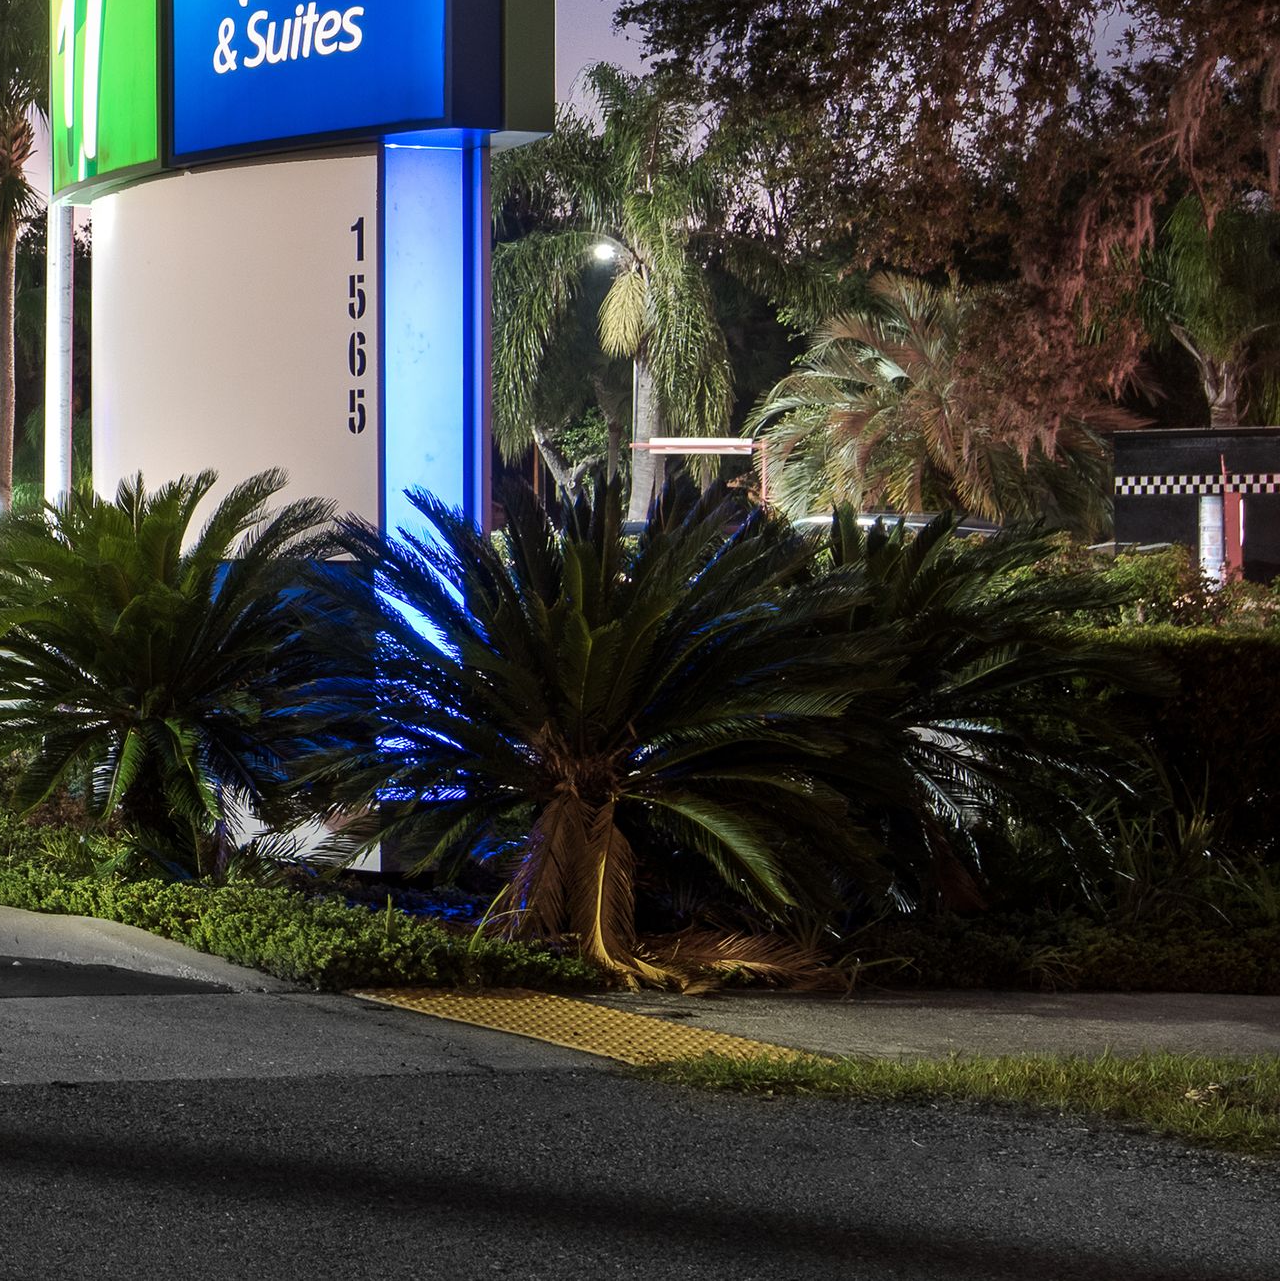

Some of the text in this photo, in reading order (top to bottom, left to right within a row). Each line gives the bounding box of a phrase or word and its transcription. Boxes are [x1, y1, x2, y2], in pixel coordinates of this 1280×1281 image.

[212, 1, 365, 74] & Suites
[348, 216, 367, 435] 1565
